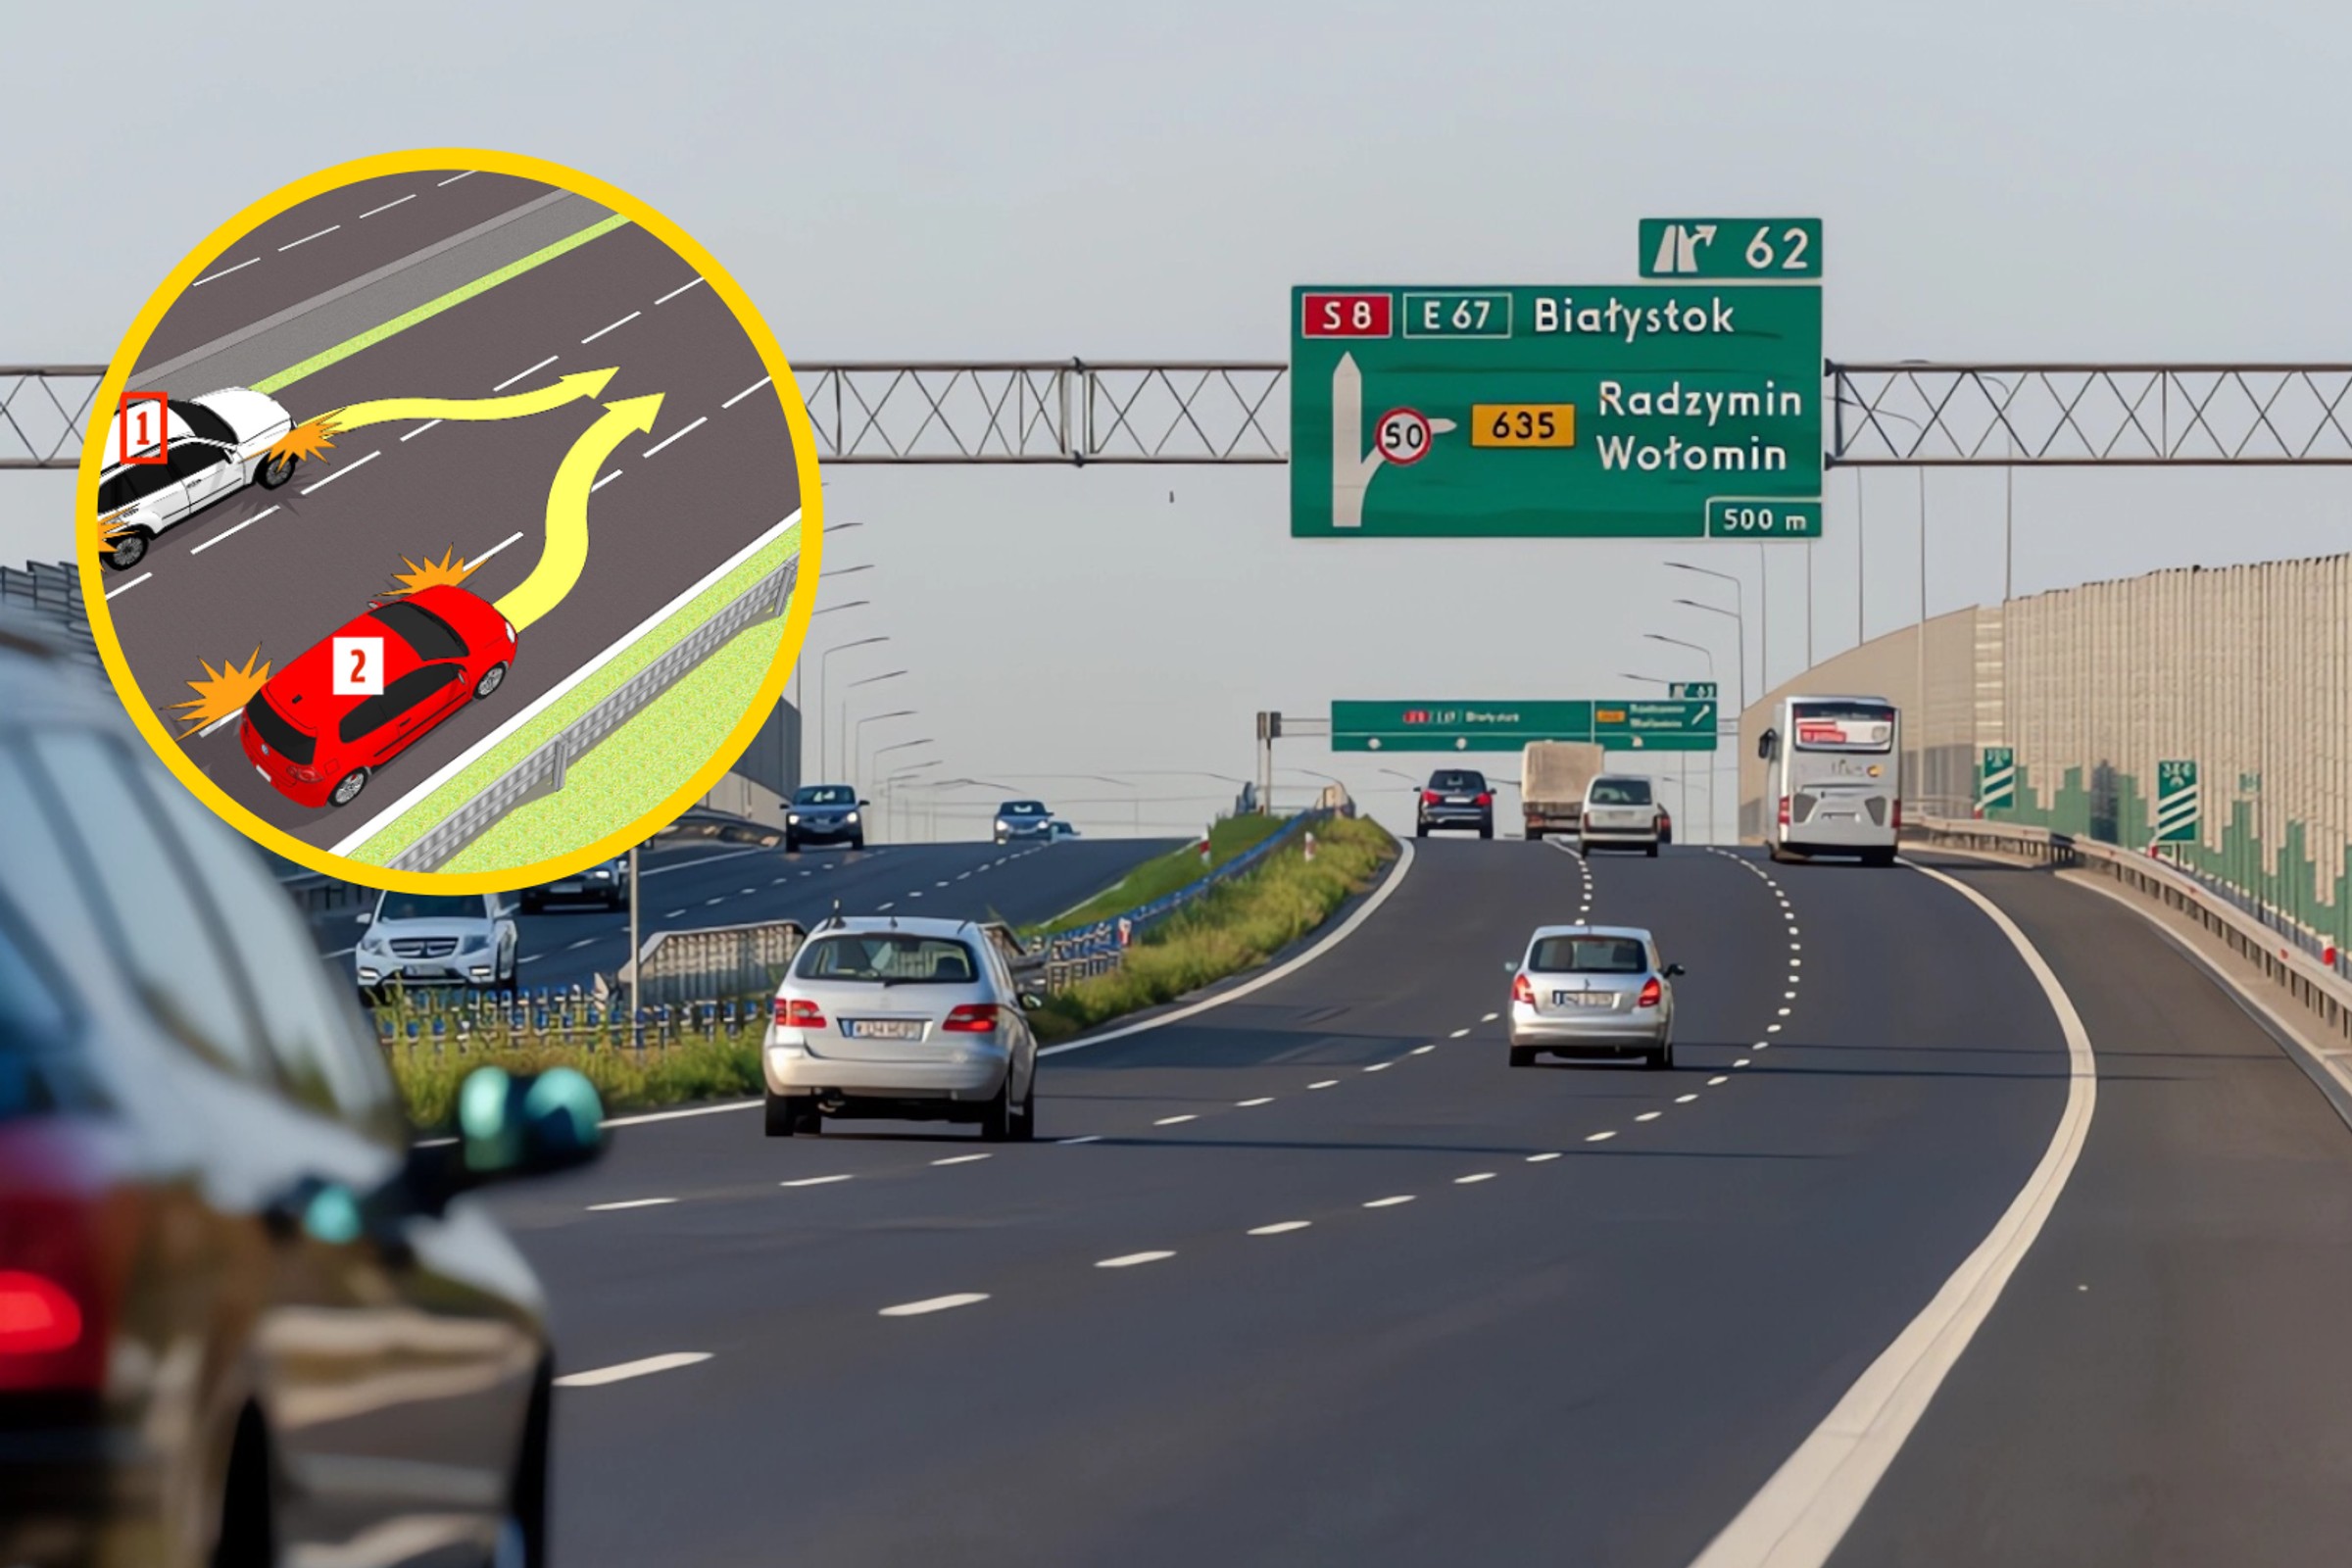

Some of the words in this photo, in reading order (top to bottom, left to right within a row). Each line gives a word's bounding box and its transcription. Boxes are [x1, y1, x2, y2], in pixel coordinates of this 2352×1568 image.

[1745, 227, 1808, 270] 62
[1323, 301, 1342, 329] S
[1351, 301, 1371, 329] 8
[1424, 301, 1440, 329] E
[1451, 301, 1491, 329] 67
[1535, 297, 1735, 343] Białystok
[1598, 381, 1801, 426] Radzymin
[1385, 423, 1424, 449] 50
[1492, 412, 1555, 440] 635
[1596, 435, 1787, 471] Wołomin
[1723, 509, 1773, 530] 500
[1786, 515, 1807, 530] m
